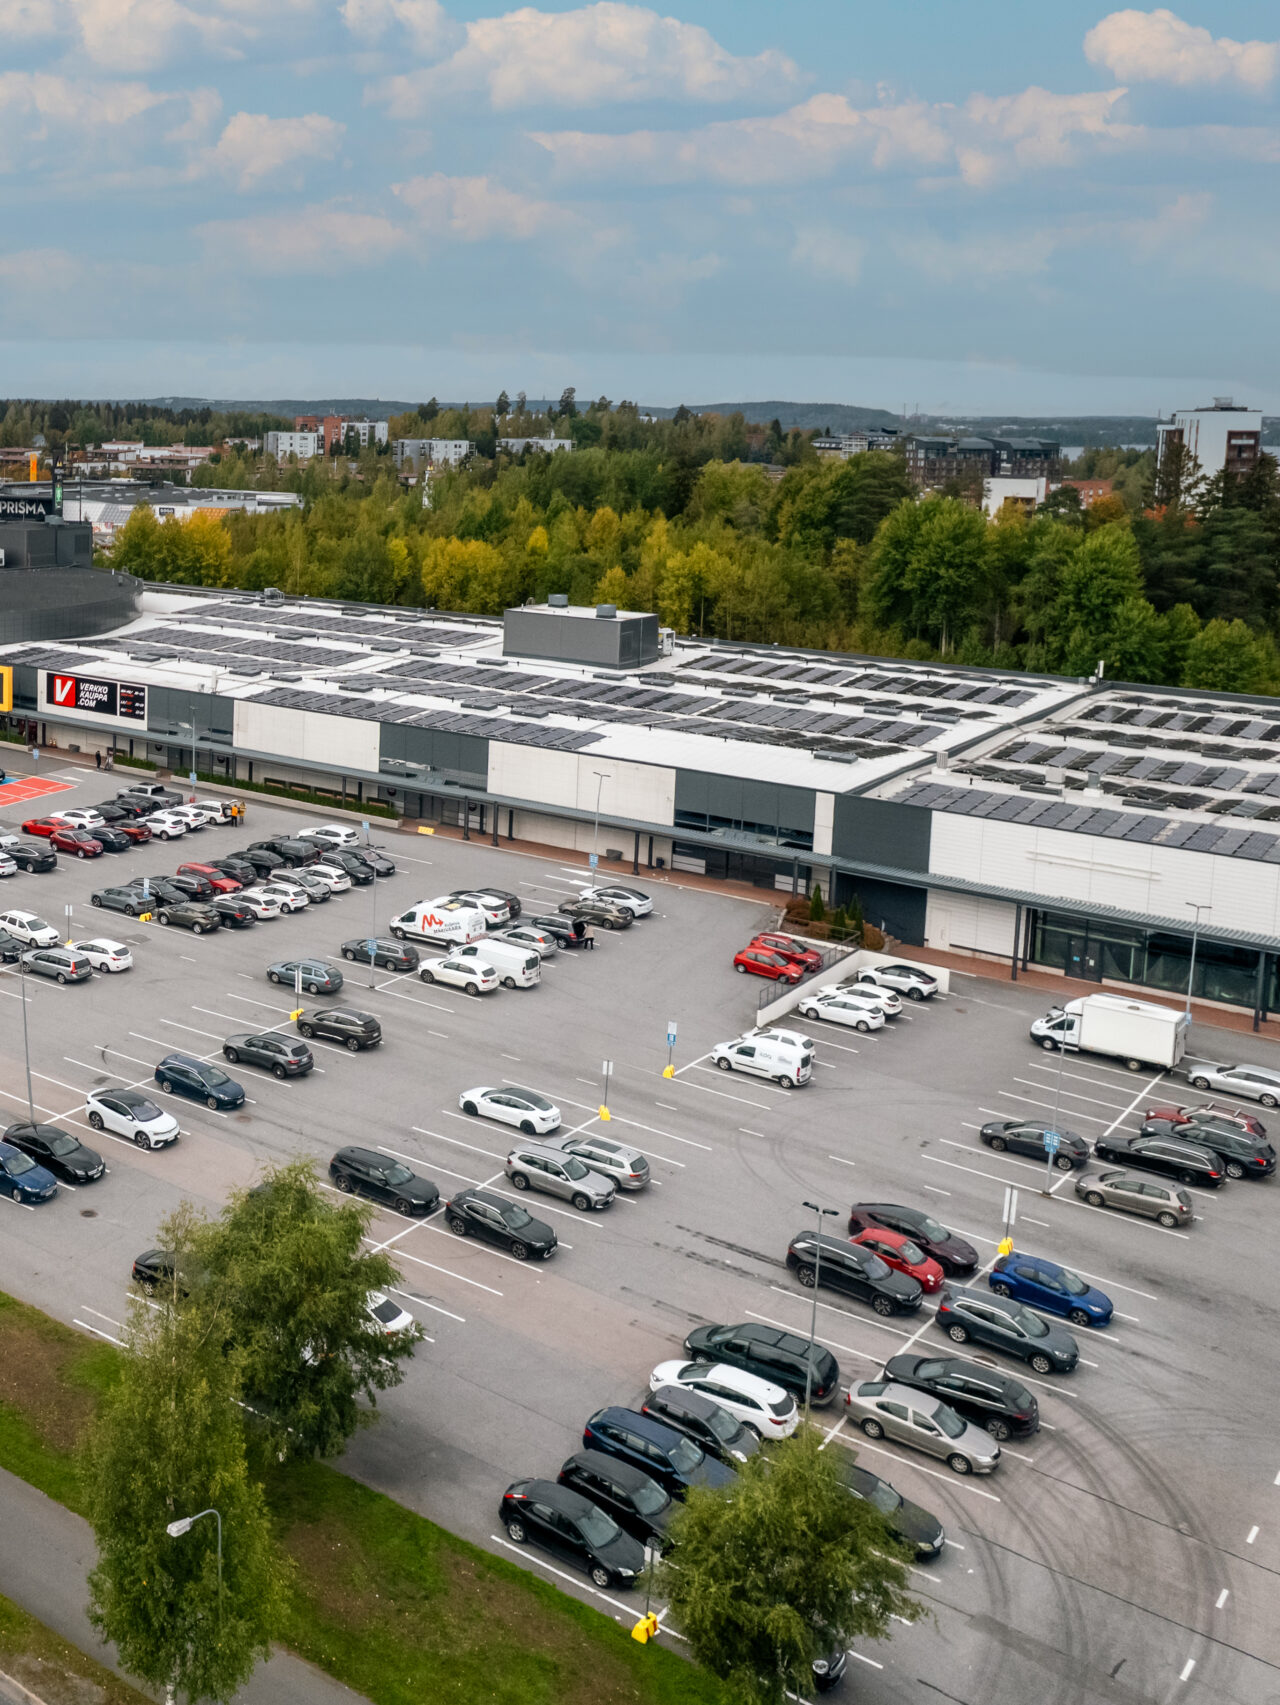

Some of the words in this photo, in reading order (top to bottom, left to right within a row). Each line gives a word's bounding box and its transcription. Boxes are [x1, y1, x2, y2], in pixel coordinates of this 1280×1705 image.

[0, 501, 46, 515] PRISMA
[80, 682, 109, 694] VERKKO
[79, 691, 108, 702] KAUPPA
[77, 699, 97, 708] .COM
